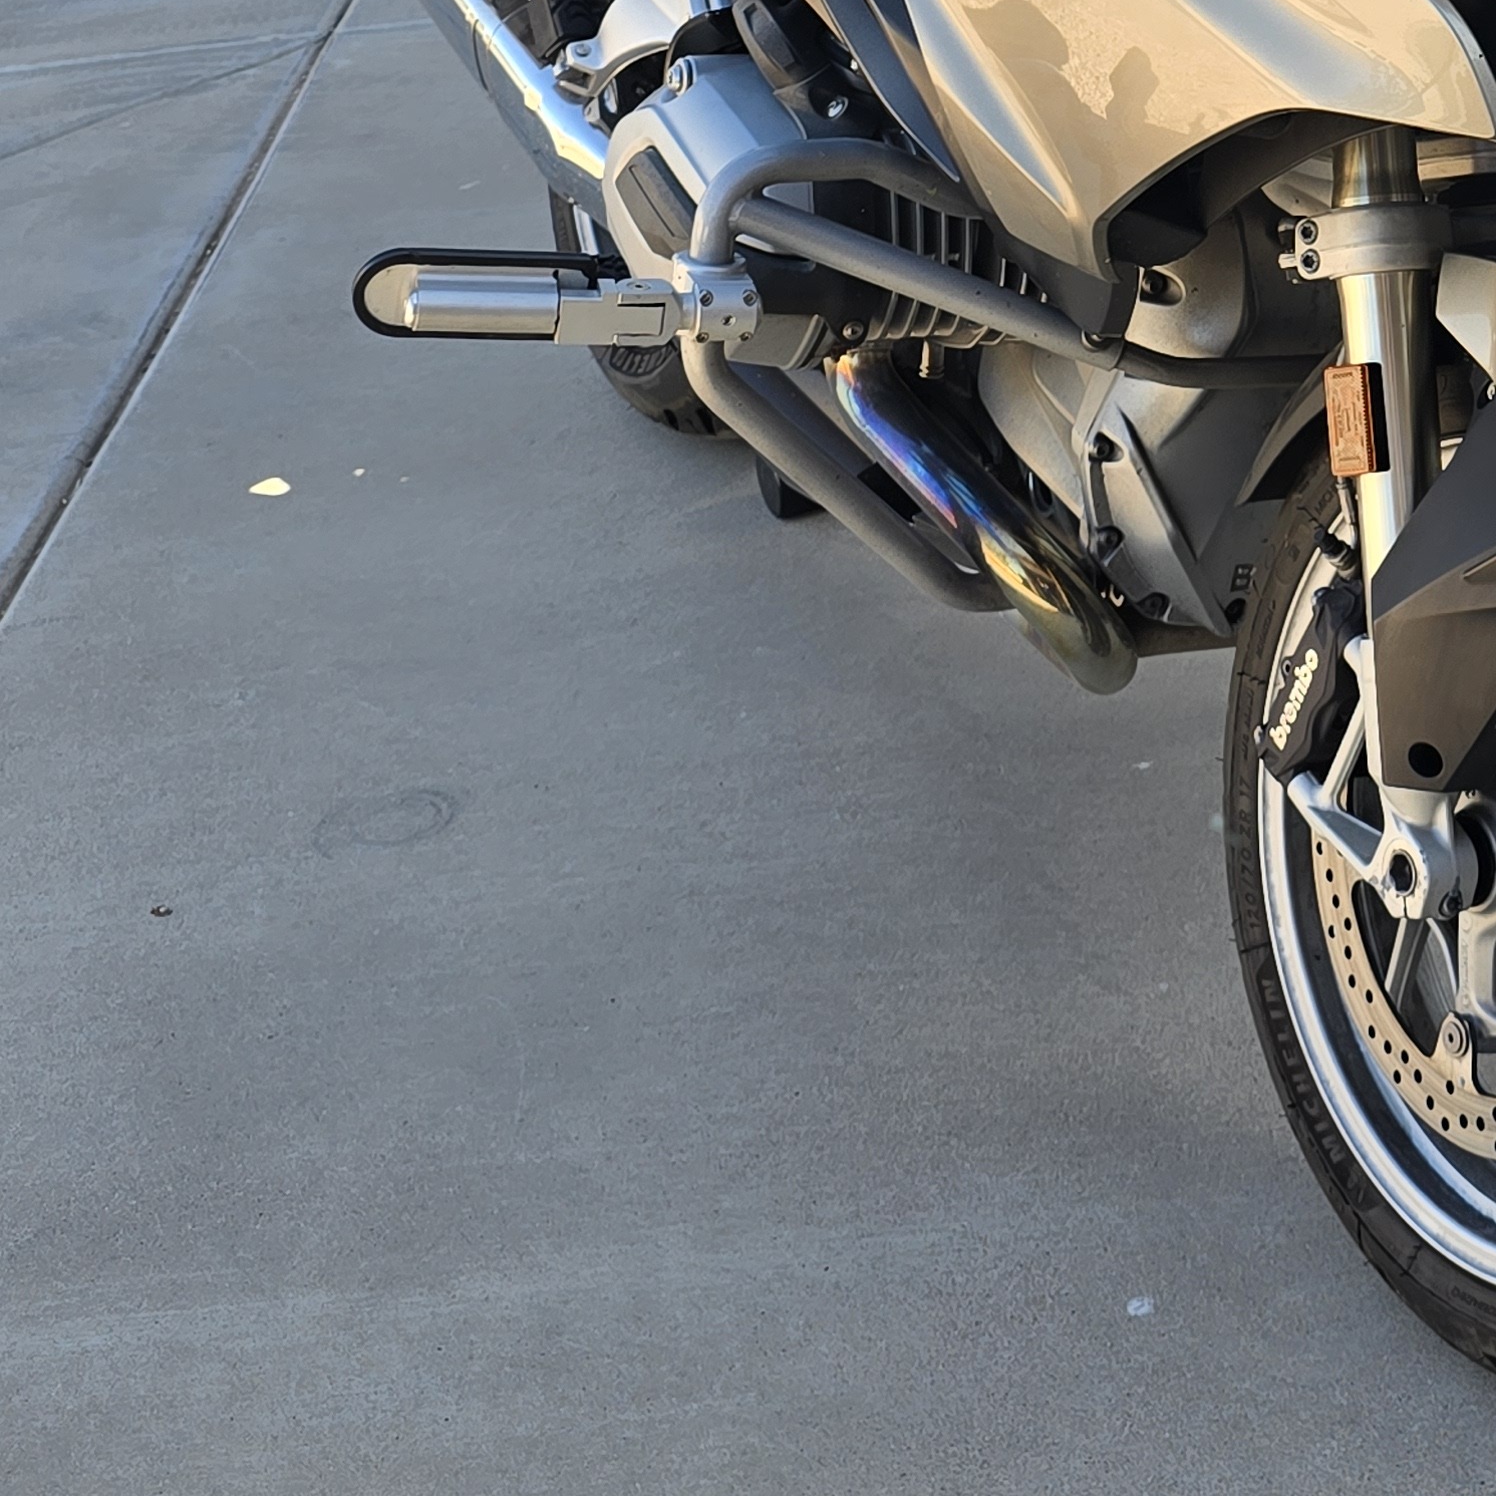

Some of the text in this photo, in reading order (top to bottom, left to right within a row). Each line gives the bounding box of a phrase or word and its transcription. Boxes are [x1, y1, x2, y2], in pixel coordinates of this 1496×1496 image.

[1268, 648, 1319, 752] brembo
[1239, 847, 1261, 930] 120/70
[1260, 978, 1342, 1165] MICHELIN
